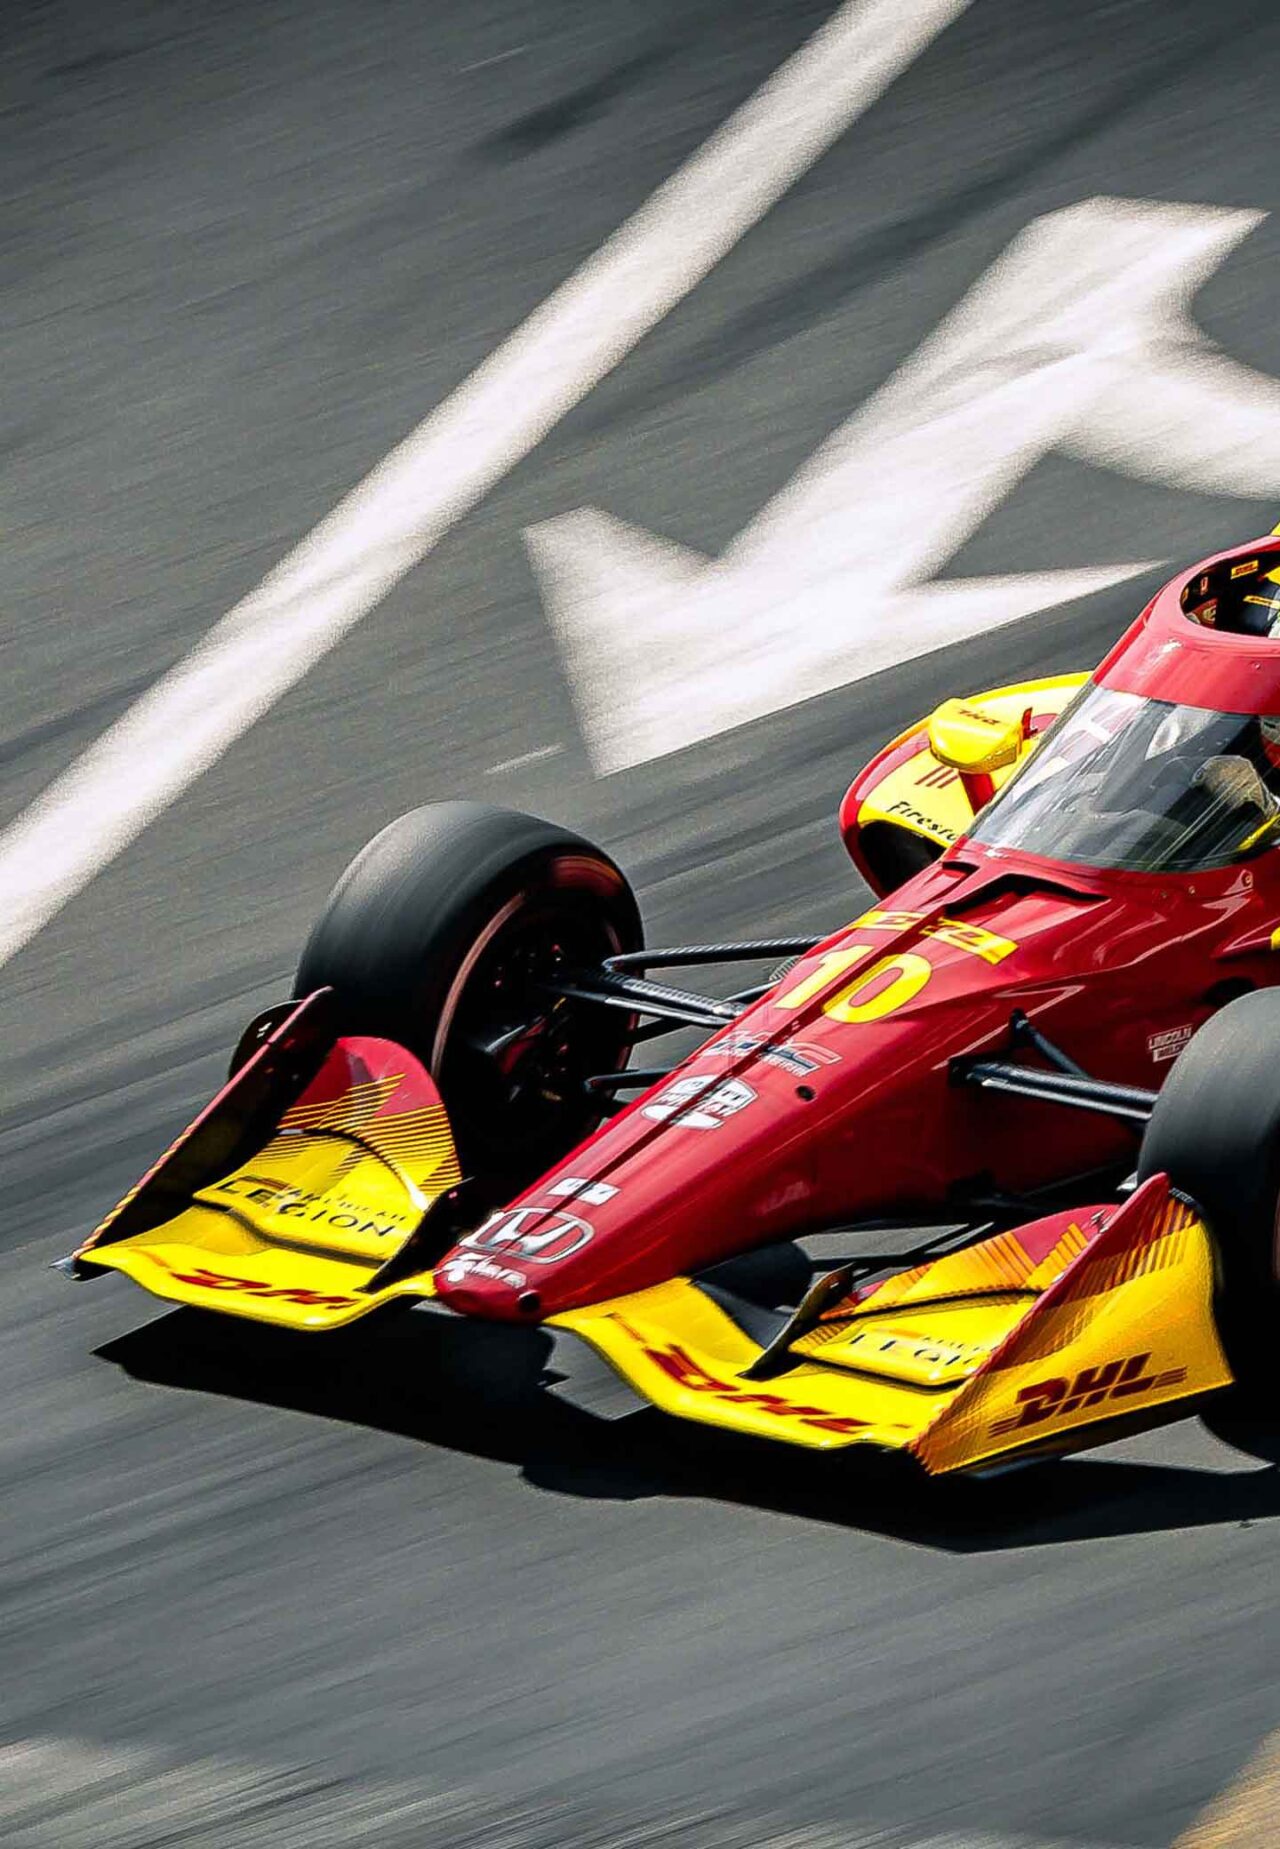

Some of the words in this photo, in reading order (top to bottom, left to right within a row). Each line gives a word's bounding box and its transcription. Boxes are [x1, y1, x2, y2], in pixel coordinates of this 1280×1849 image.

[774, 944, 933, 1024] 10
[216, 1180, 395, 1236] LEGION
[1014, 1352, 1157, 1426] DHL
